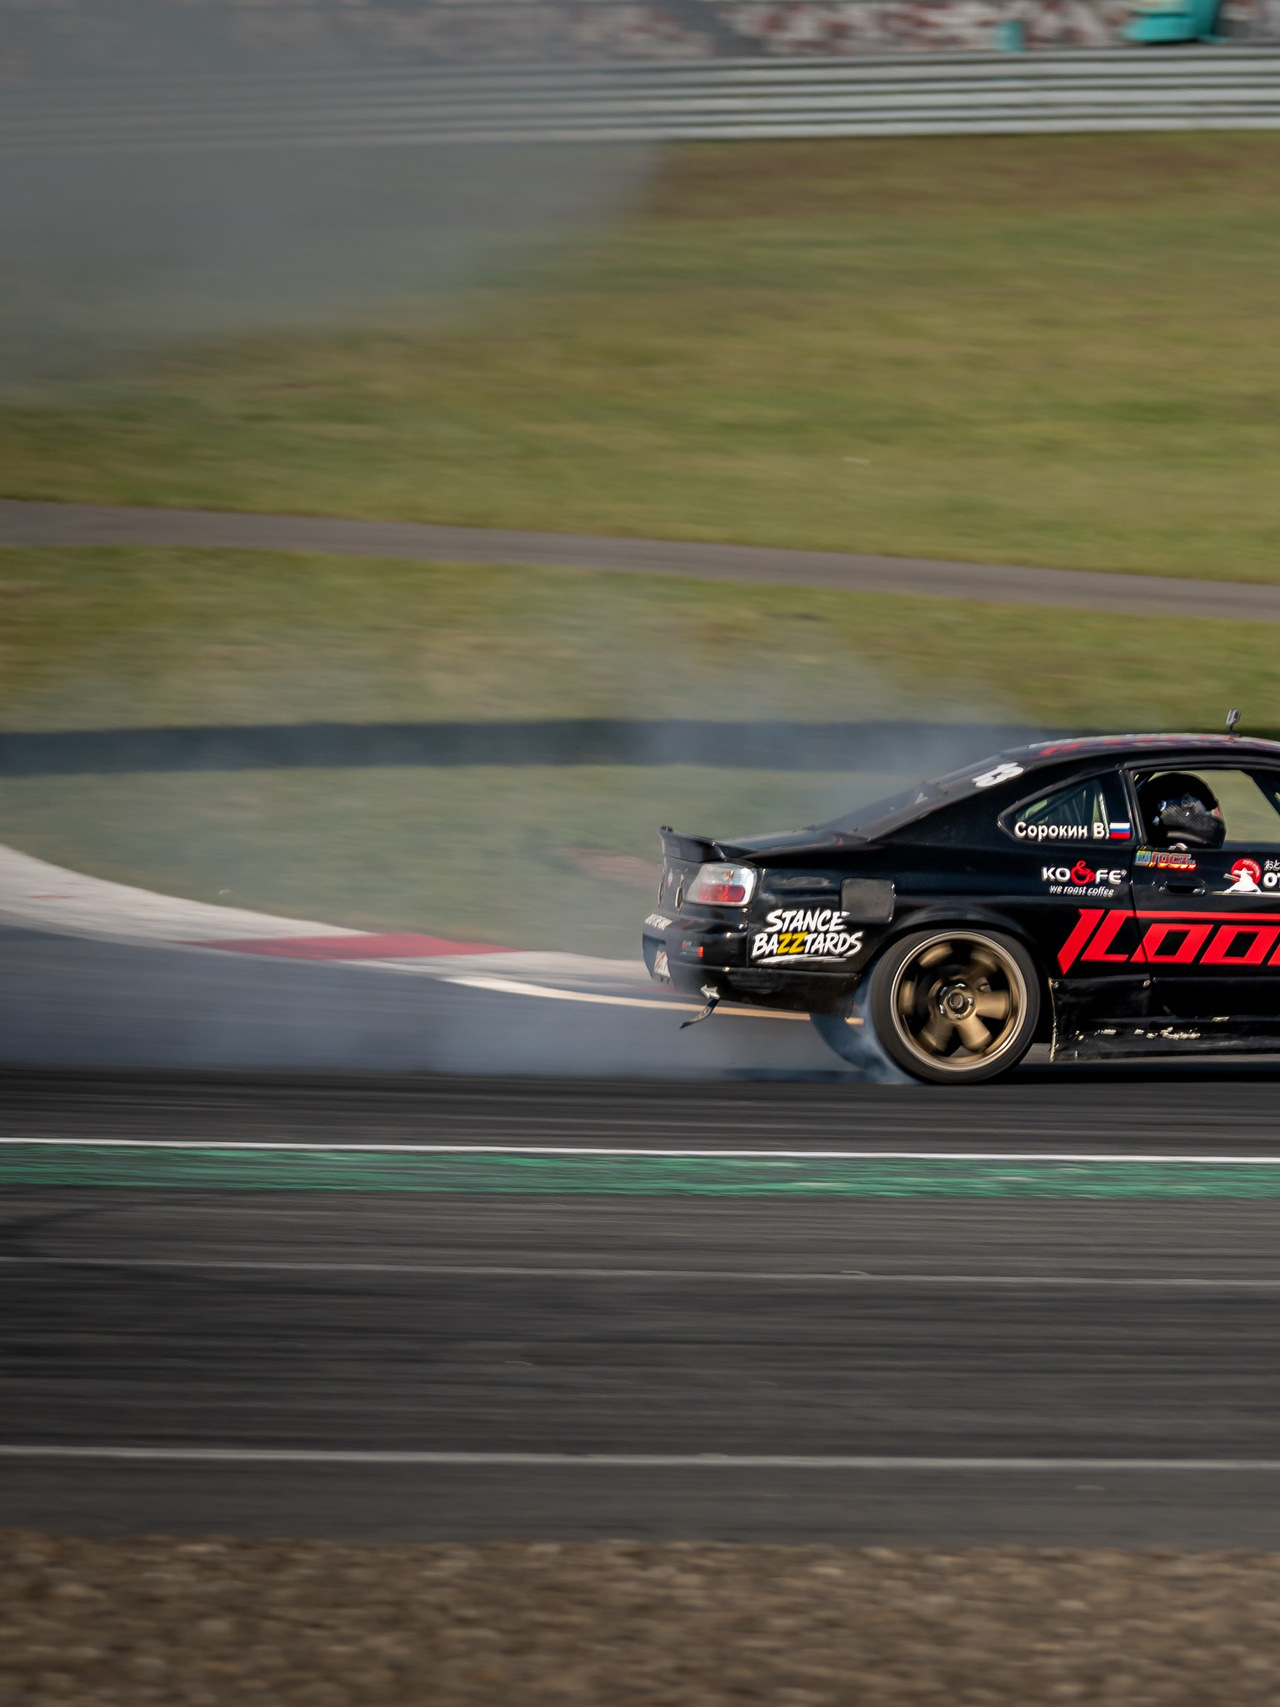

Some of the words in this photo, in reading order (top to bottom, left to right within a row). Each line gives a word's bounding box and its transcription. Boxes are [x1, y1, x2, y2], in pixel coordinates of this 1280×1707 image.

[1014, 821, 1088, 842] Сорокин
[1049, 885, 1062, 894] we
[1064, 886, 1087, 896] roast
[1087, 886, 1115, 898] coffee
[764, 907, 851, 933] STANCE
[751, 931, 864, 959] BAZZTARDS
